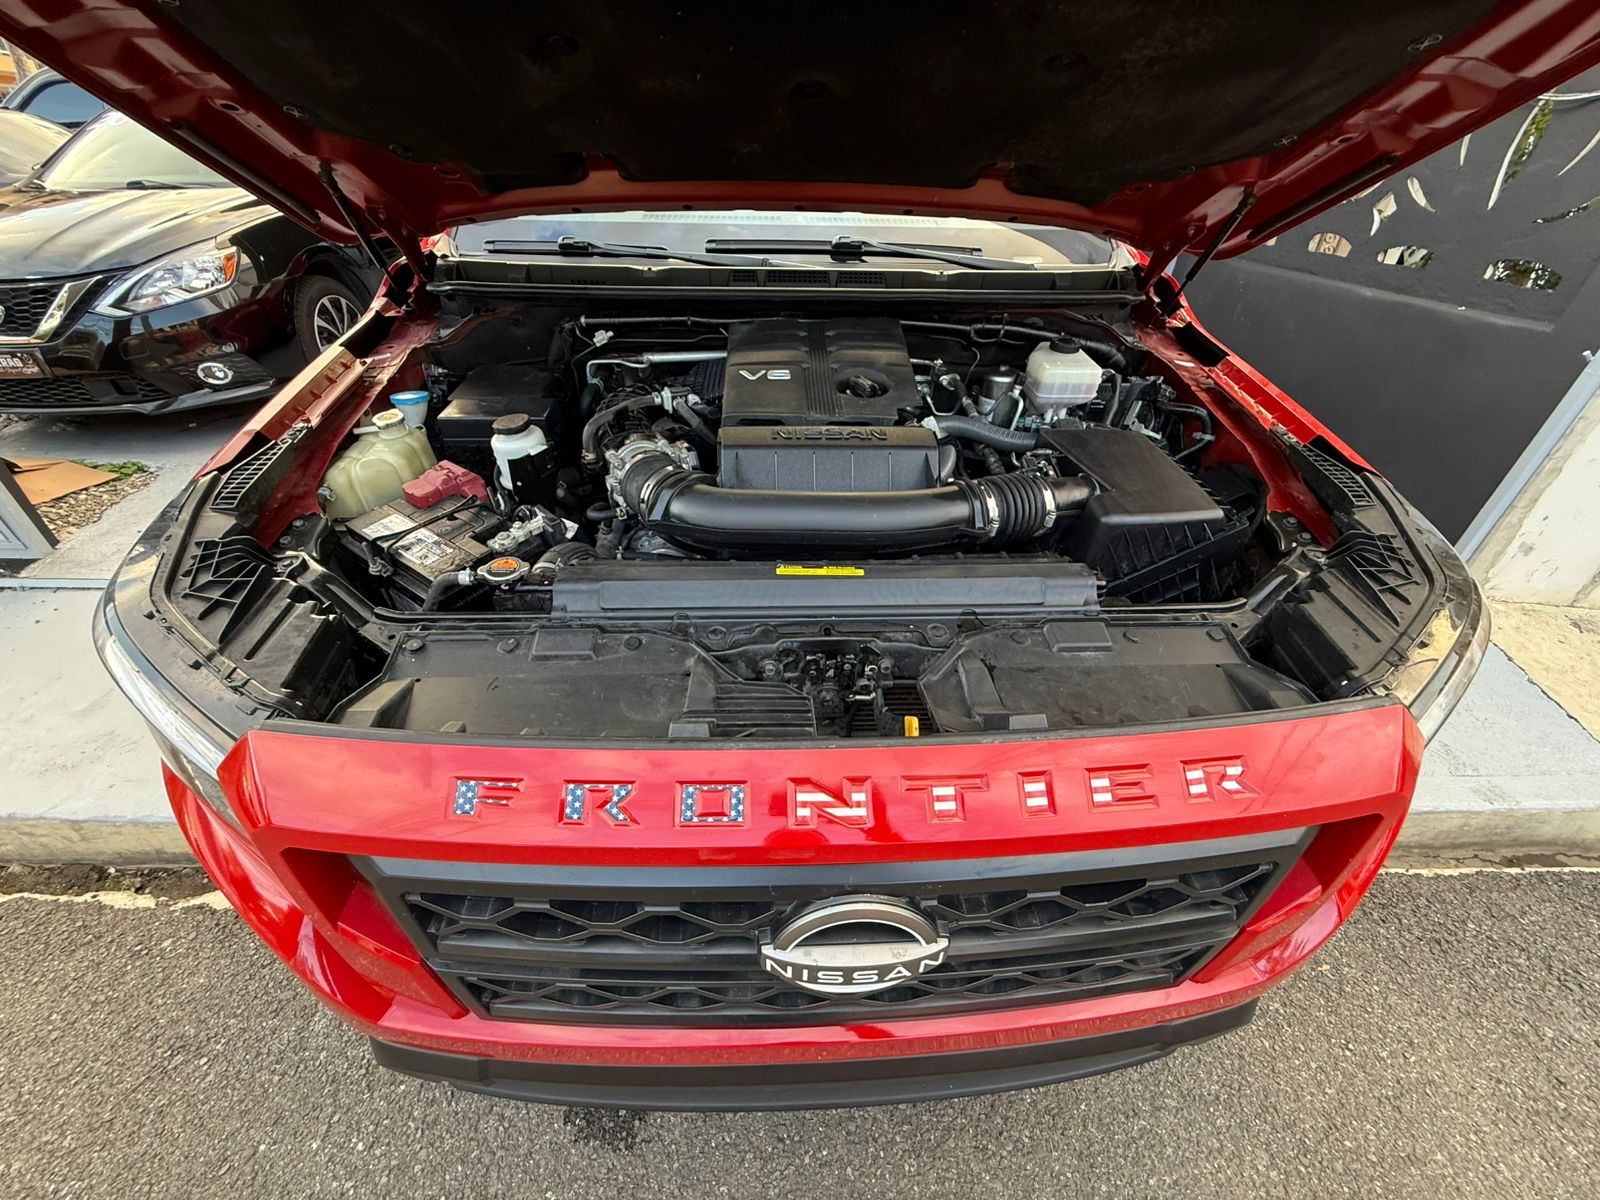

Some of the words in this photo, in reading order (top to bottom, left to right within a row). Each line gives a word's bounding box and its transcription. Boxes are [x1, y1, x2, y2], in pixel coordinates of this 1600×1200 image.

[739, 369, 791, 381] V6
[772, 428, 887, 441] NISSAN
[448, 755, 1260, 829] FRONTIER
[765, 951, 945, 984] NISSAN
